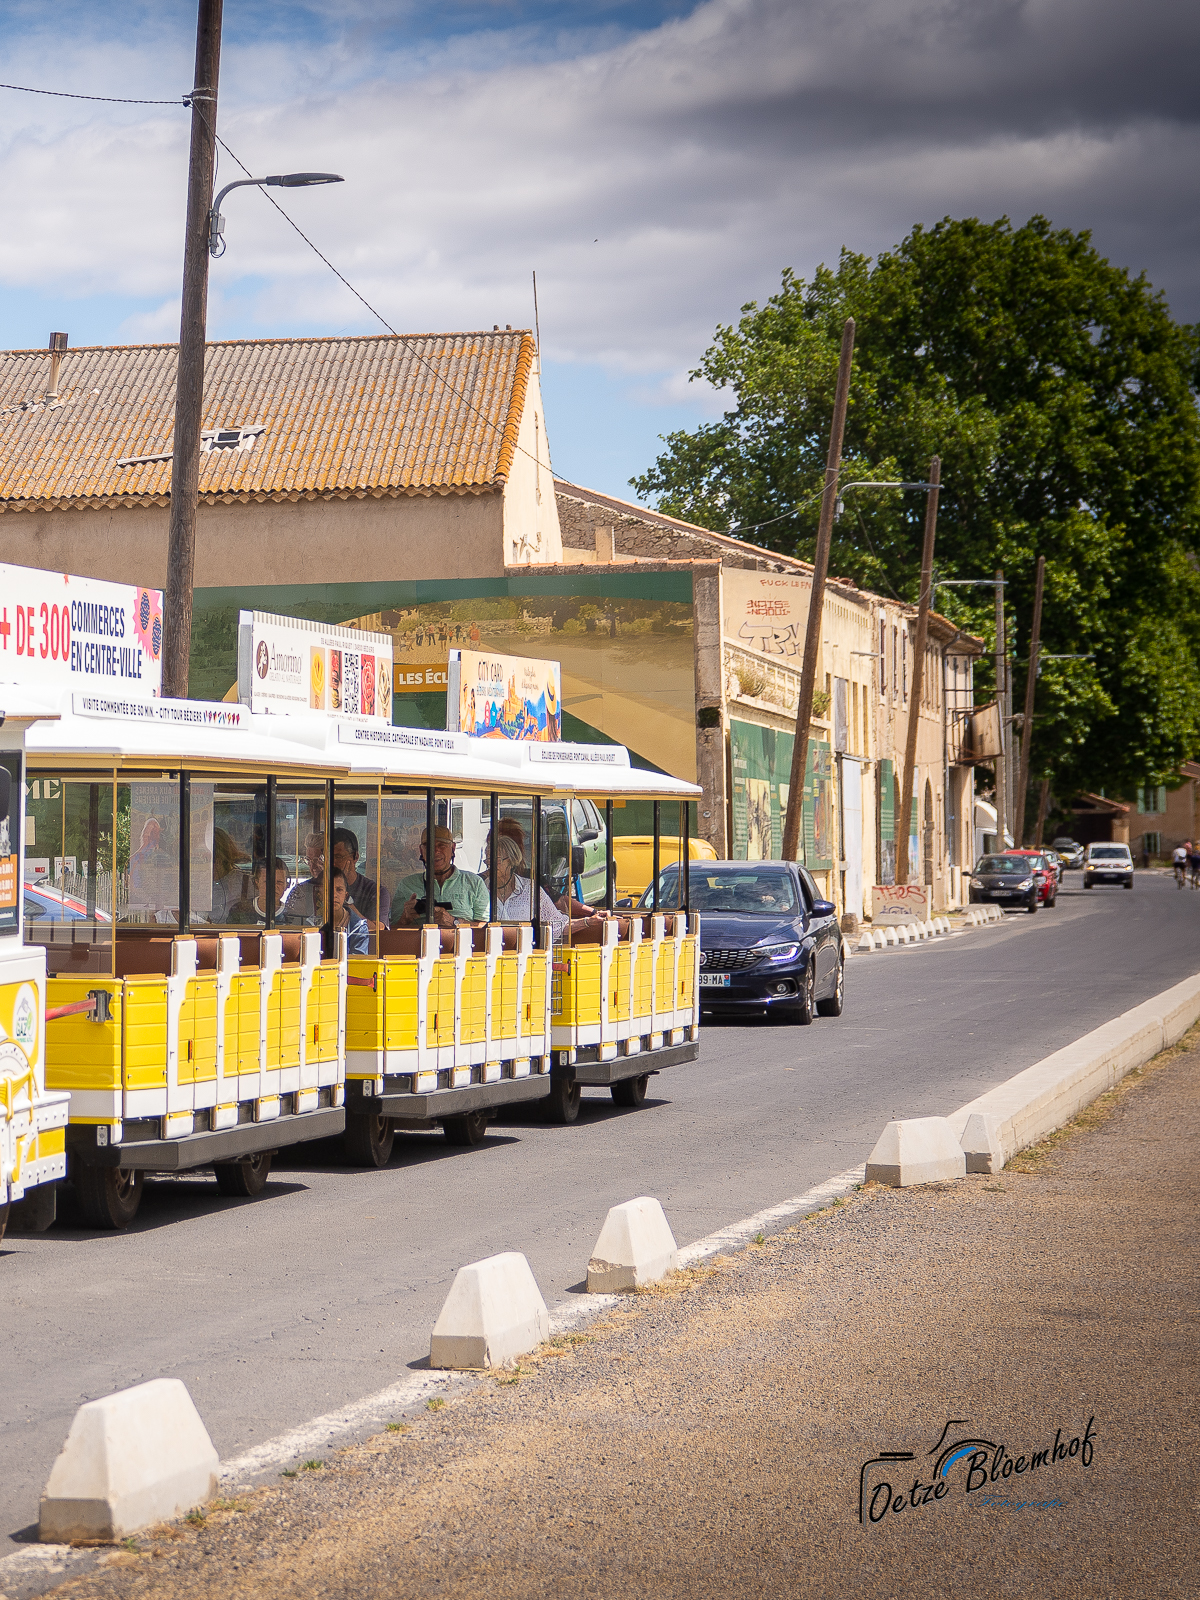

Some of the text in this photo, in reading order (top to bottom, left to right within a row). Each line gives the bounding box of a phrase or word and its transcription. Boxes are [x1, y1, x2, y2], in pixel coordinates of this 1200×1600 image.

[760, 579, 788, 587] FUCK
[71, 600, 125, 638] COMMERCES
[17, 605, 35, 657] DE
[40, 602, 70, 662] 300
[71, 640, 143, 679] EN CENTRE-VILLE
[269, 642, 302, 674] Amorino
[399, 668, 448, 685] LES ÉCL
[478, 660, 489, 681] CITY
[491, 663, 504, 682] CARD
[83, 698, 99, 711] VISITE
[100, 700, 129, 715] COMMENTÉE
[130, 705, 137, 716] DE
[138, 706, 144, 717] 50
[159, 708, 170, 719] CITY
[171, 709, 183, 721] TOUR
[184, 708, 202, 722] BÉZIERS
[355, 729, 370, 740] CENTRE
[392, 732, 414, 745] CATHÉDRALE
